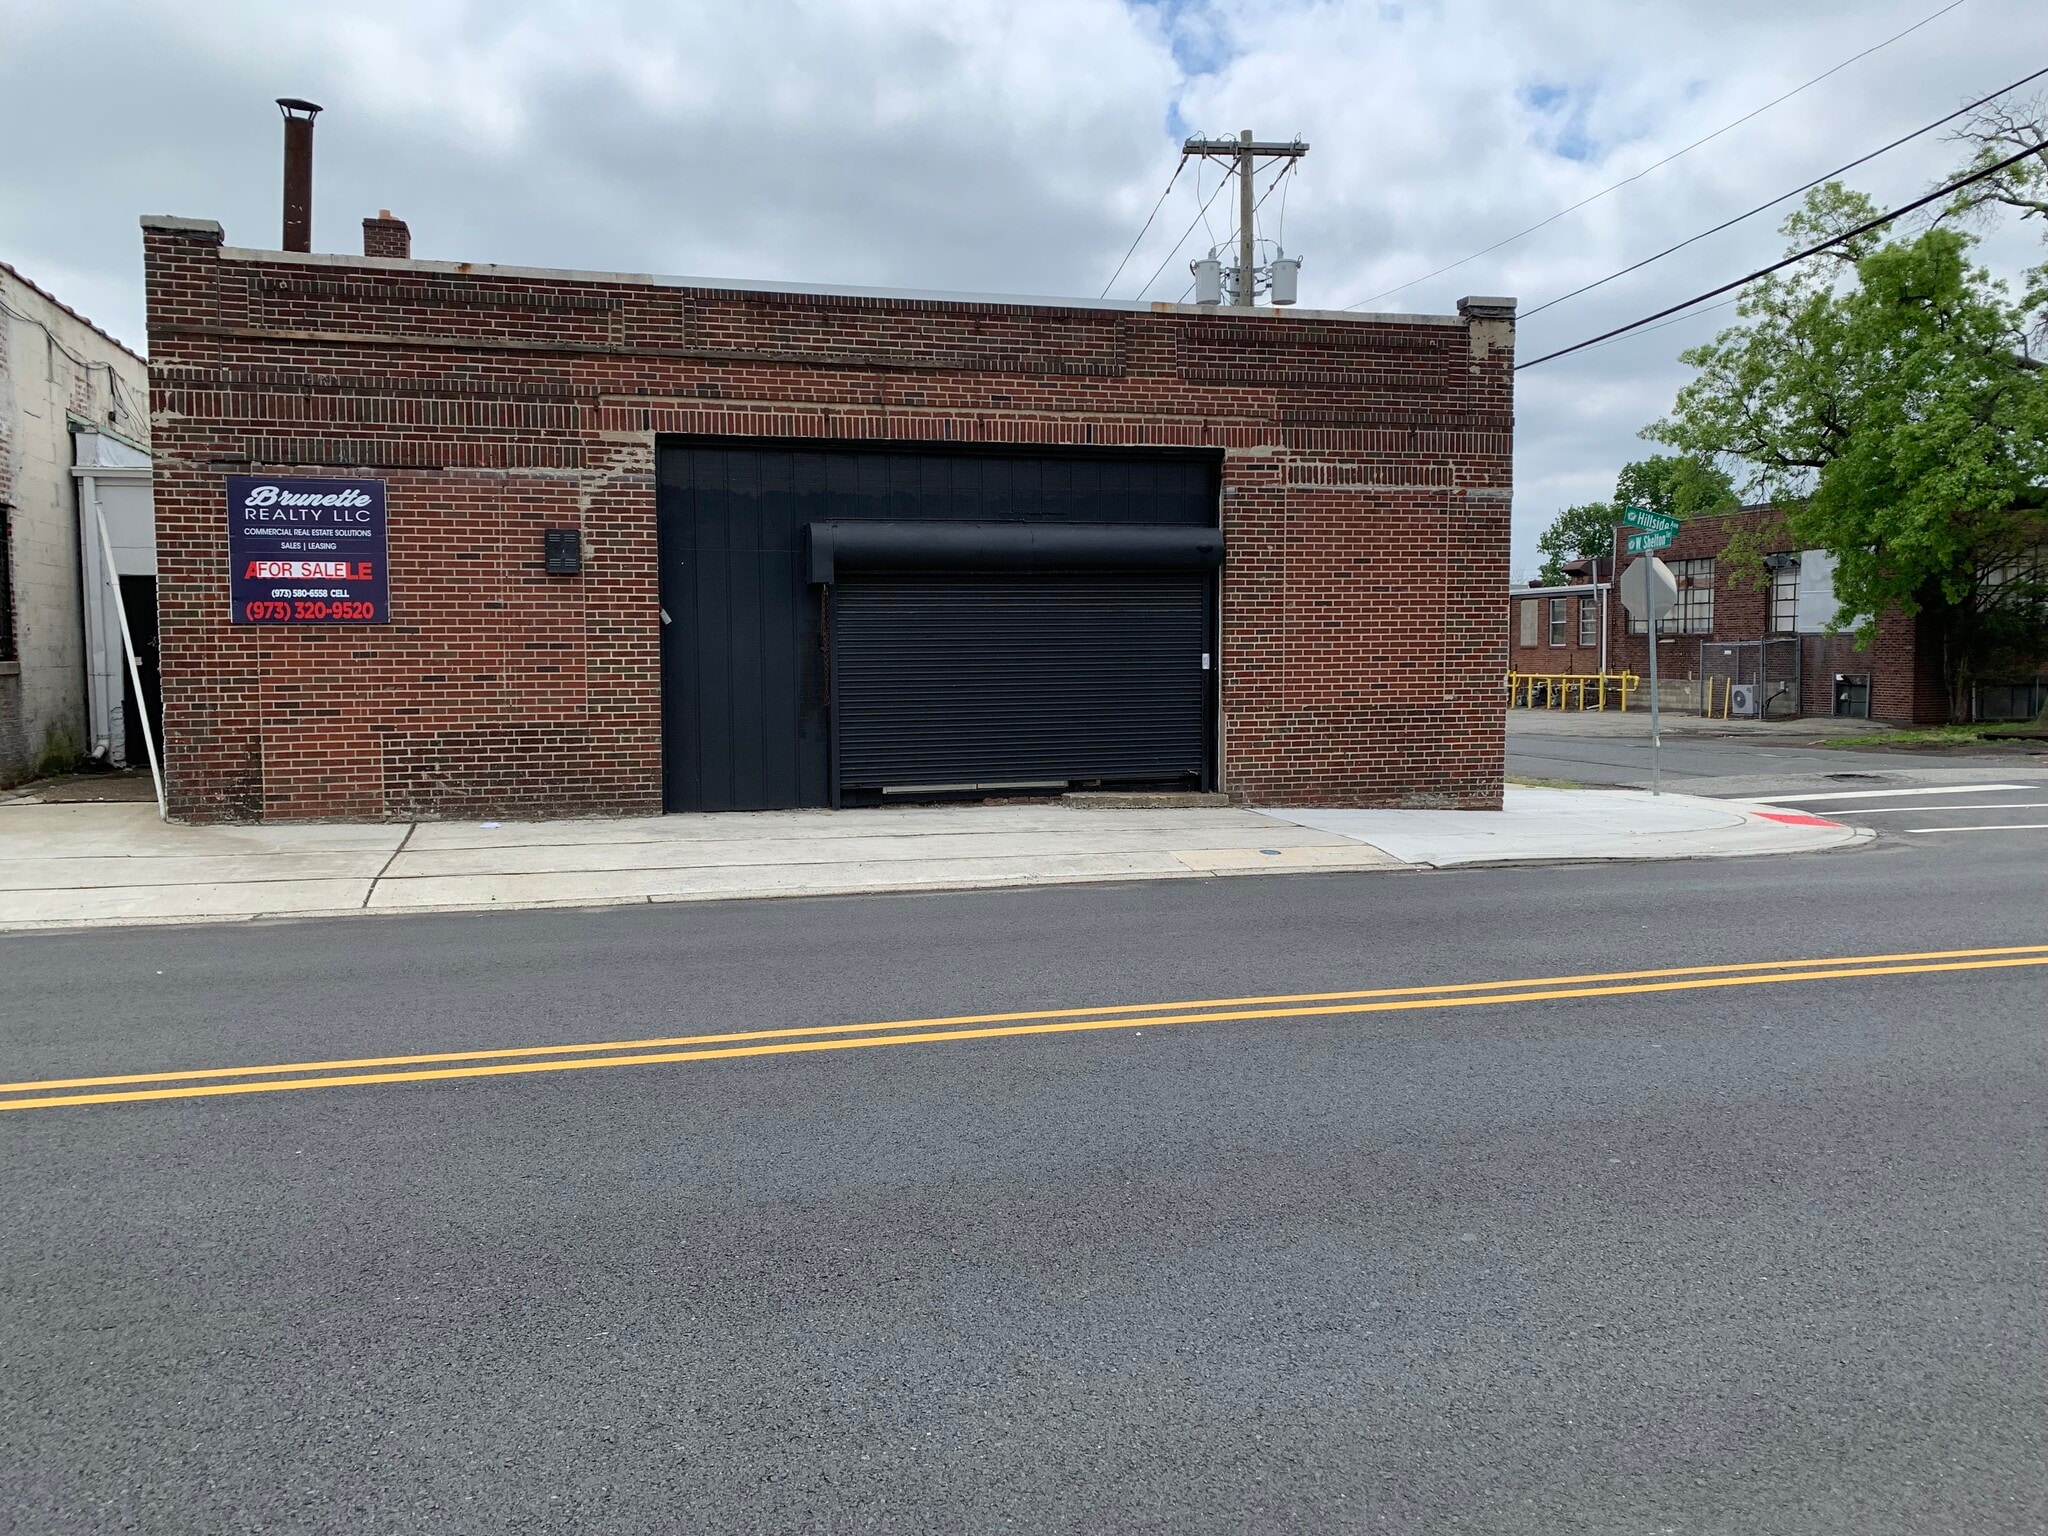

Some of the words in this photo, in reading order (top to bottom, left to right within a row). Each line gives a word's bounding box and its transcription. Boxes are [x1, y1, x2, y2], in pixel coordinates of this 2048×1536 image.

[245, 485, 372, 507] Brunette
[245, 508, 322, 521] REALTY
[333, 510, 371, 522] LLC
[1637, 512, 1669, 530] Hillside
[244, 528, 292, 536] COMMERCIAL
[294, 528, 310, 536] REAL
[311, 529, 334, 537] ESTATE
[334, 529, 372, 537] SOLUTIONS
[281, 542, 301, 550] SALES
[308, 542, 337, 550] LEASING
[1643, 534, 1666, 549] Shelton
[258, 562, 293, 577] FOR
[301, 562, 345, 577] SALE
[271, 589, 292, 598] (973)
[292, 589, 328, 598] 580-6558
[330, 589, 350, 598] CELL
[246, 601, 291, 621] (973)
[294, 601, 374, 619] 320-9520
